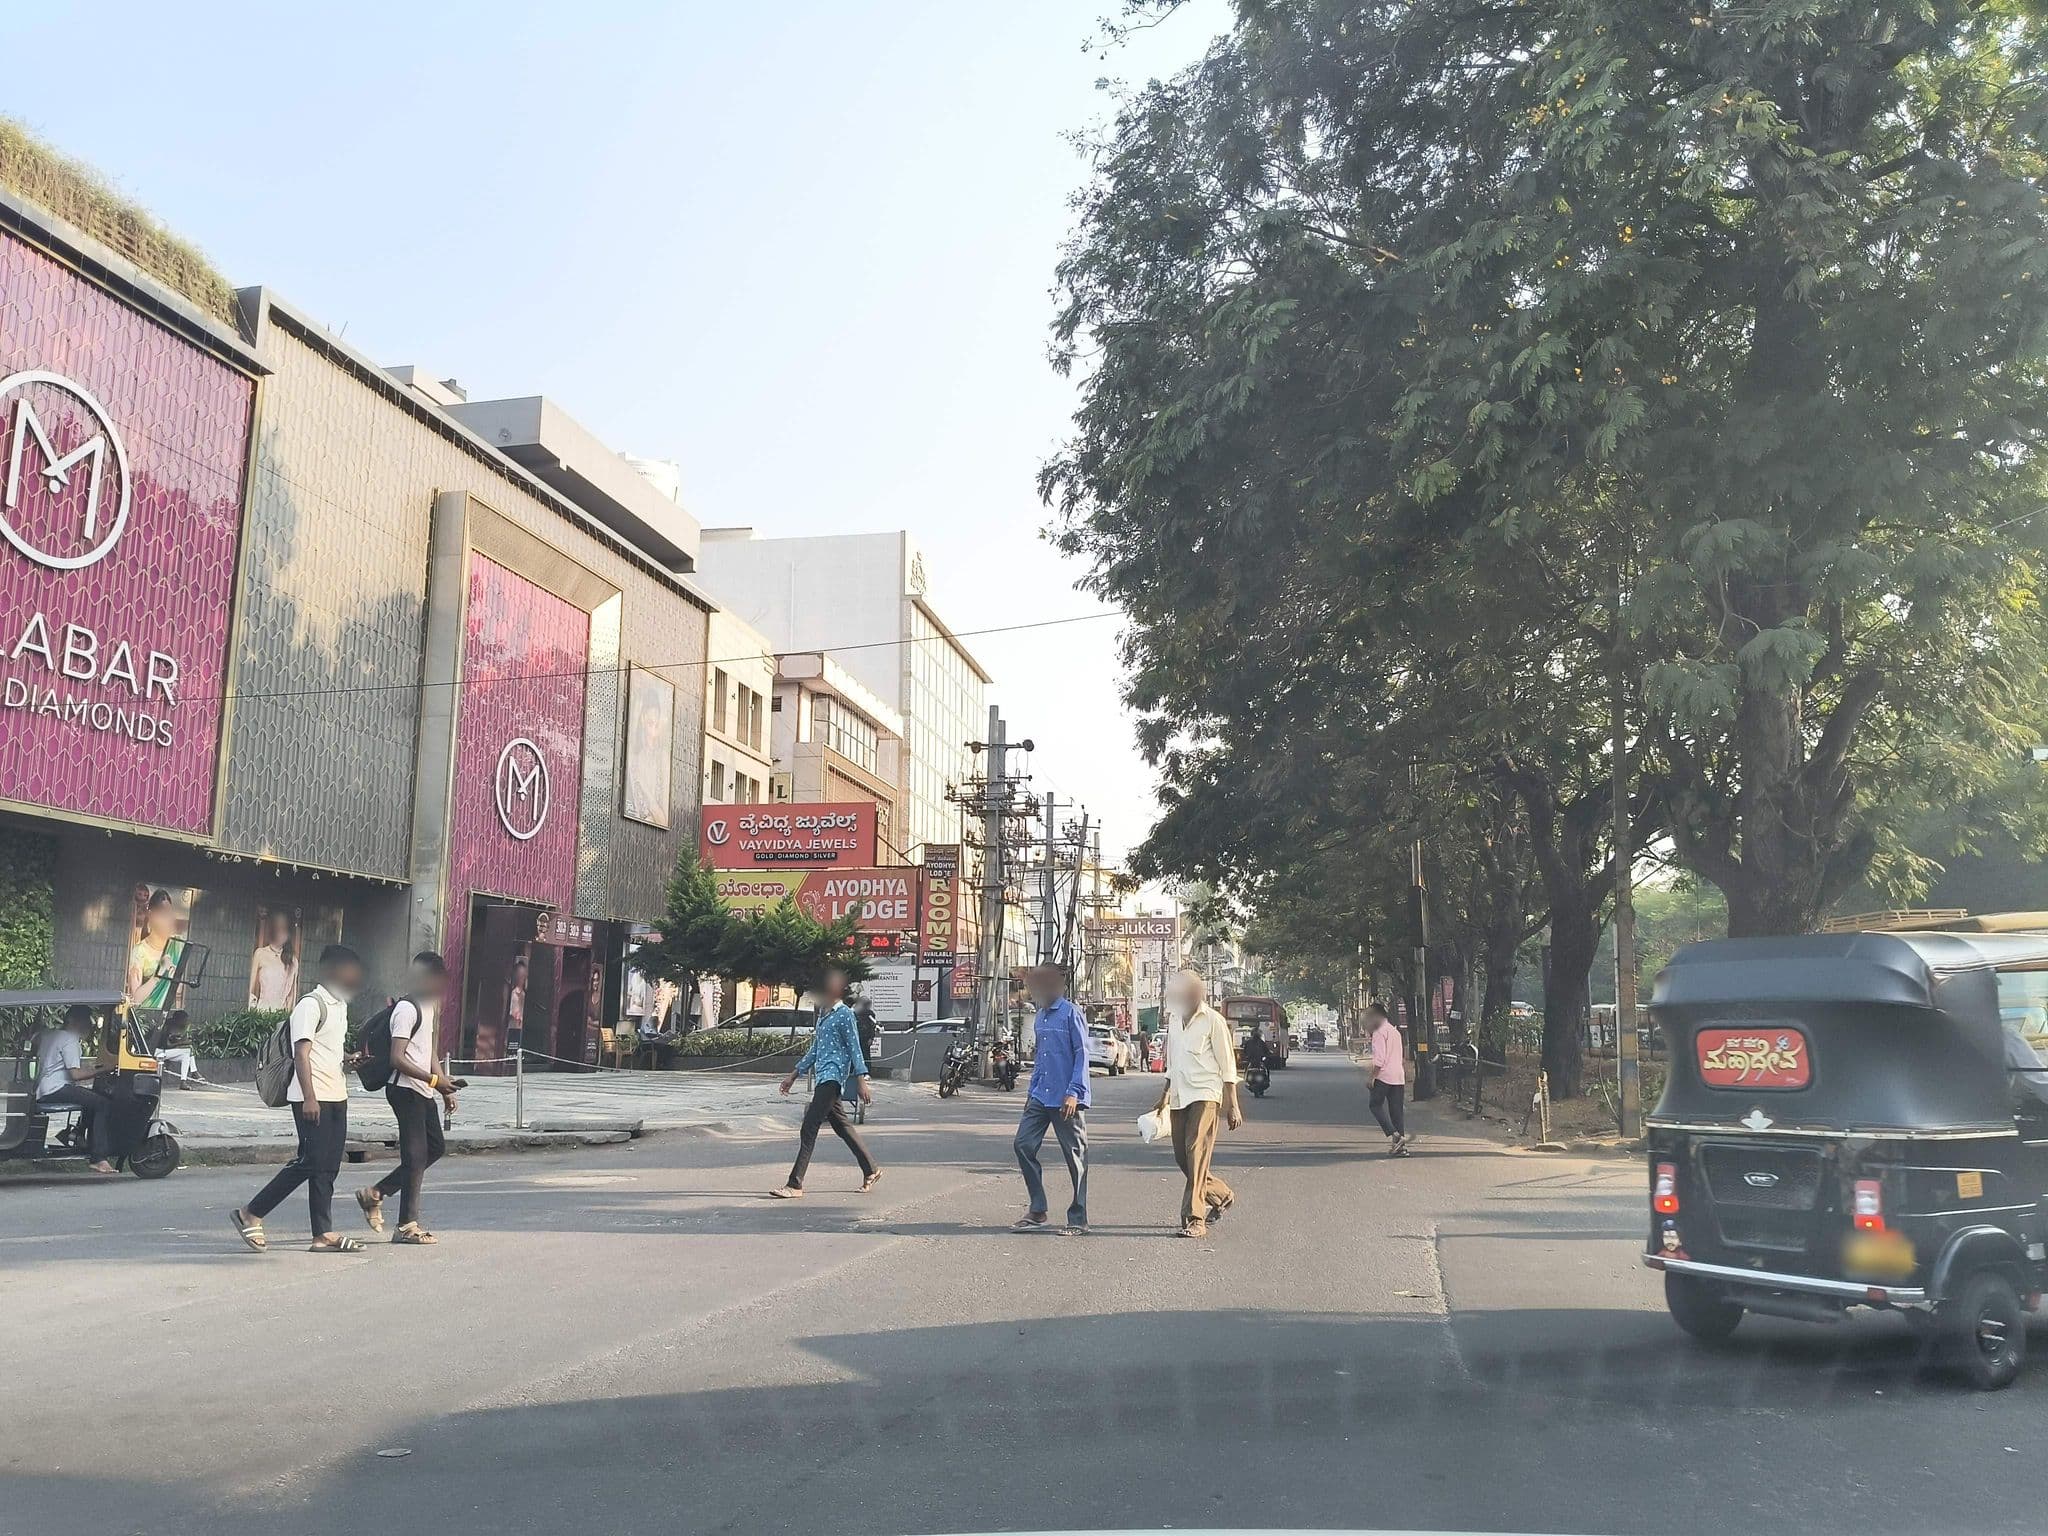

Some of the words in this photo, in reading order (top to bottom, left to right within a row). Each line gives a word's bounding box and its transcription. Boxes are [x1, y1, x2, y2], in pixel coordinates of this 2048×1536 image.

[0, 612, 179, 706] ABAR
[7, 676, 173, 747] DIAMONDS
[739, 813, 792, 836] ವೈವಿಧ್ಯ
[739, 839, 802, 850] VAYVIDYA
[805, 838, 857, 849] JEWELS
[824, 878, 908, 897] AYODHYA
[926, 879, 952, 951] ROOMS
